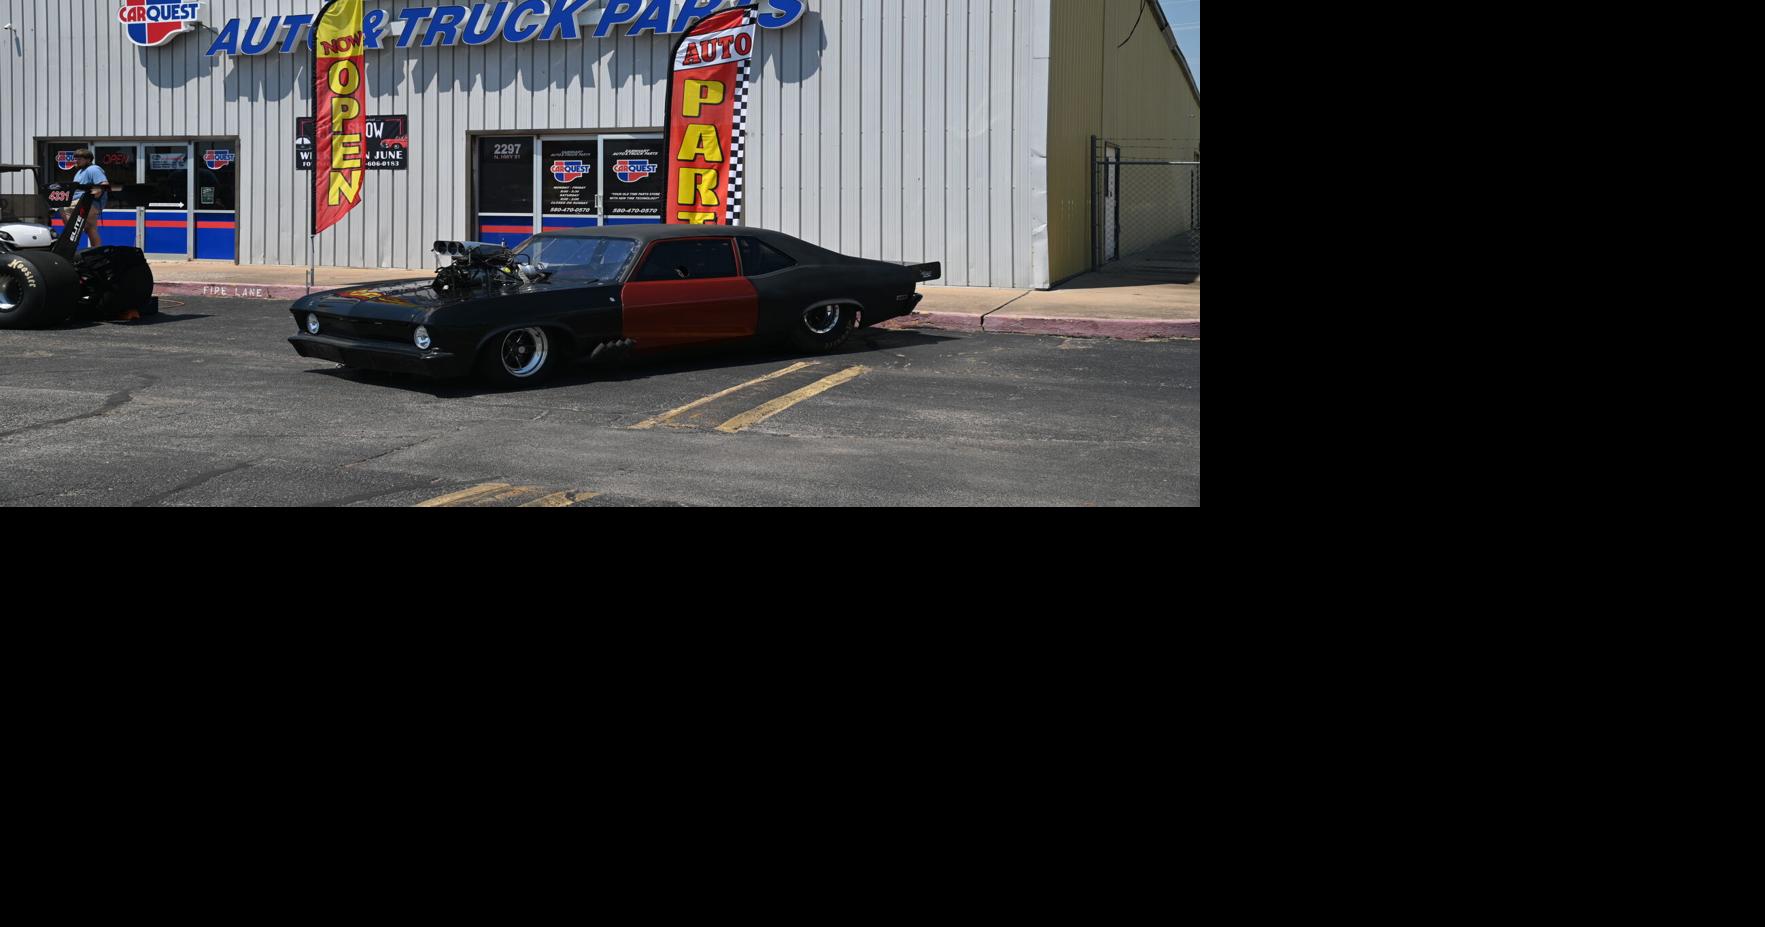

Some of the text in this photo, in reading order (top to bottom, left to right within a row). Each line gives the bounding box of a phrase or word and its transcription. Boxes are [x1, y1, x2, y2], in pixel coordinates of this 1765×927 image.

[119, 3, 199, 22] CARQUEST
[206, 14, 317, 56] AUT
[395, 0, 599, 48] TRUCK
[320, 30, 364, 56] NOW
[682, 33, 752, 66] AUTO
[327, 59, 362, 207] OPEN
[374, 150, 404, 160] JUNE
[494, 143, 522, 155] 2297
[551, 164, 589, 173] CARQUEST
[613, 164, 657, 173] CARQUEST
[69, 216, 82, 242] ELITE
[8, 259, 37, 288] Hoosier
[234, 288, 263, 297] LANE
